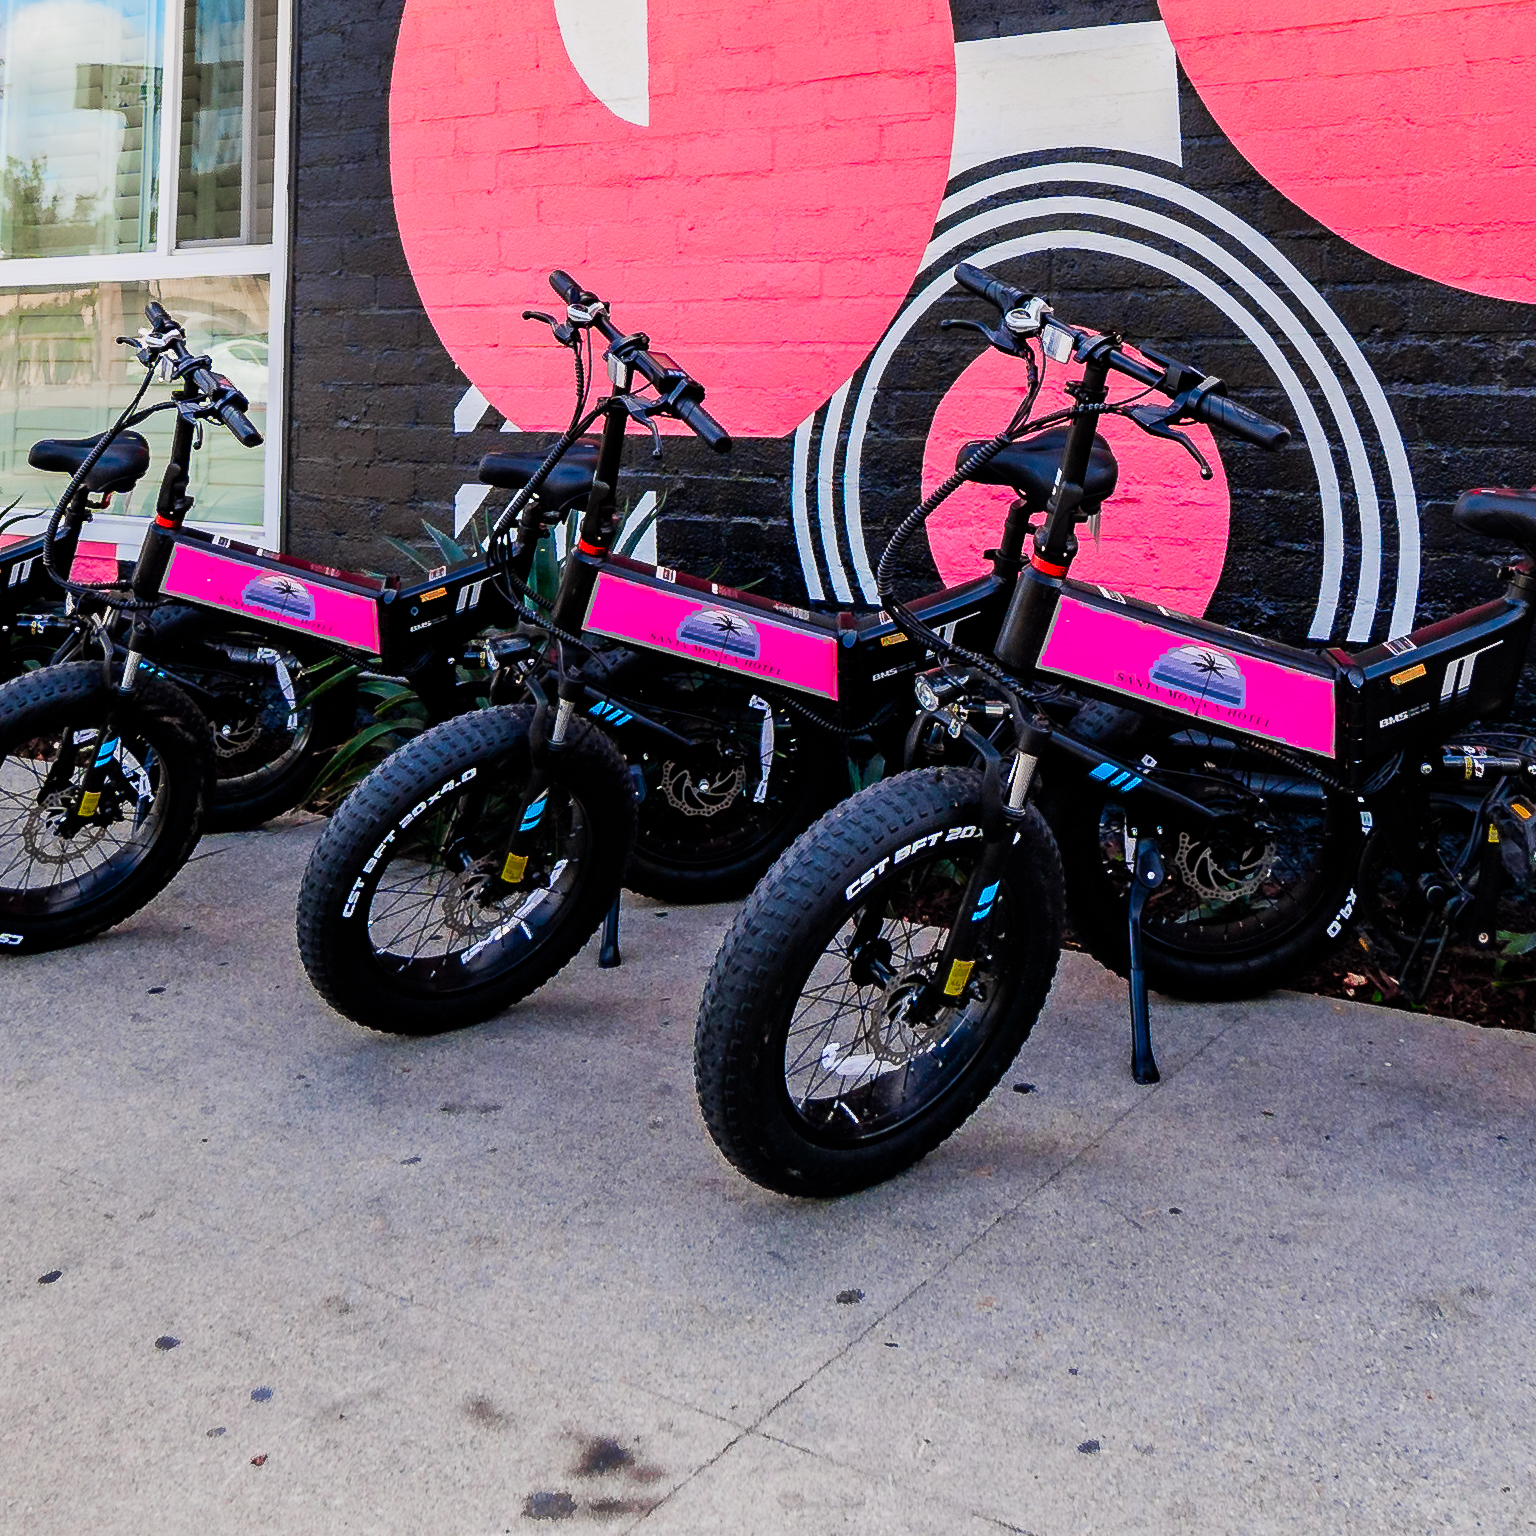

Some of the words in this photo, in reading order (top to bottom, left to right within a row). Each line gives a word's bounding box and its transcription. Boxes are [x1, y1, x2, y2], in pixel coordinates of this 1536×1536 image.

[650, 632, 688, 650] SANTA
[744, 659, 783, 676] HOTEL
[1116, 672, 1160, 694] SANTA
[1167, 689, 1221, 716] MONICA
[1227, 707, 1271, 728] HOTEL
[1379, 710, 1409, 729] BMS
[342, 876, 365, 918] CST
[362, 829, 396, 874] BFT
[845, 857, 890, 901] CST
[894, 830, 944, 865] BFT
